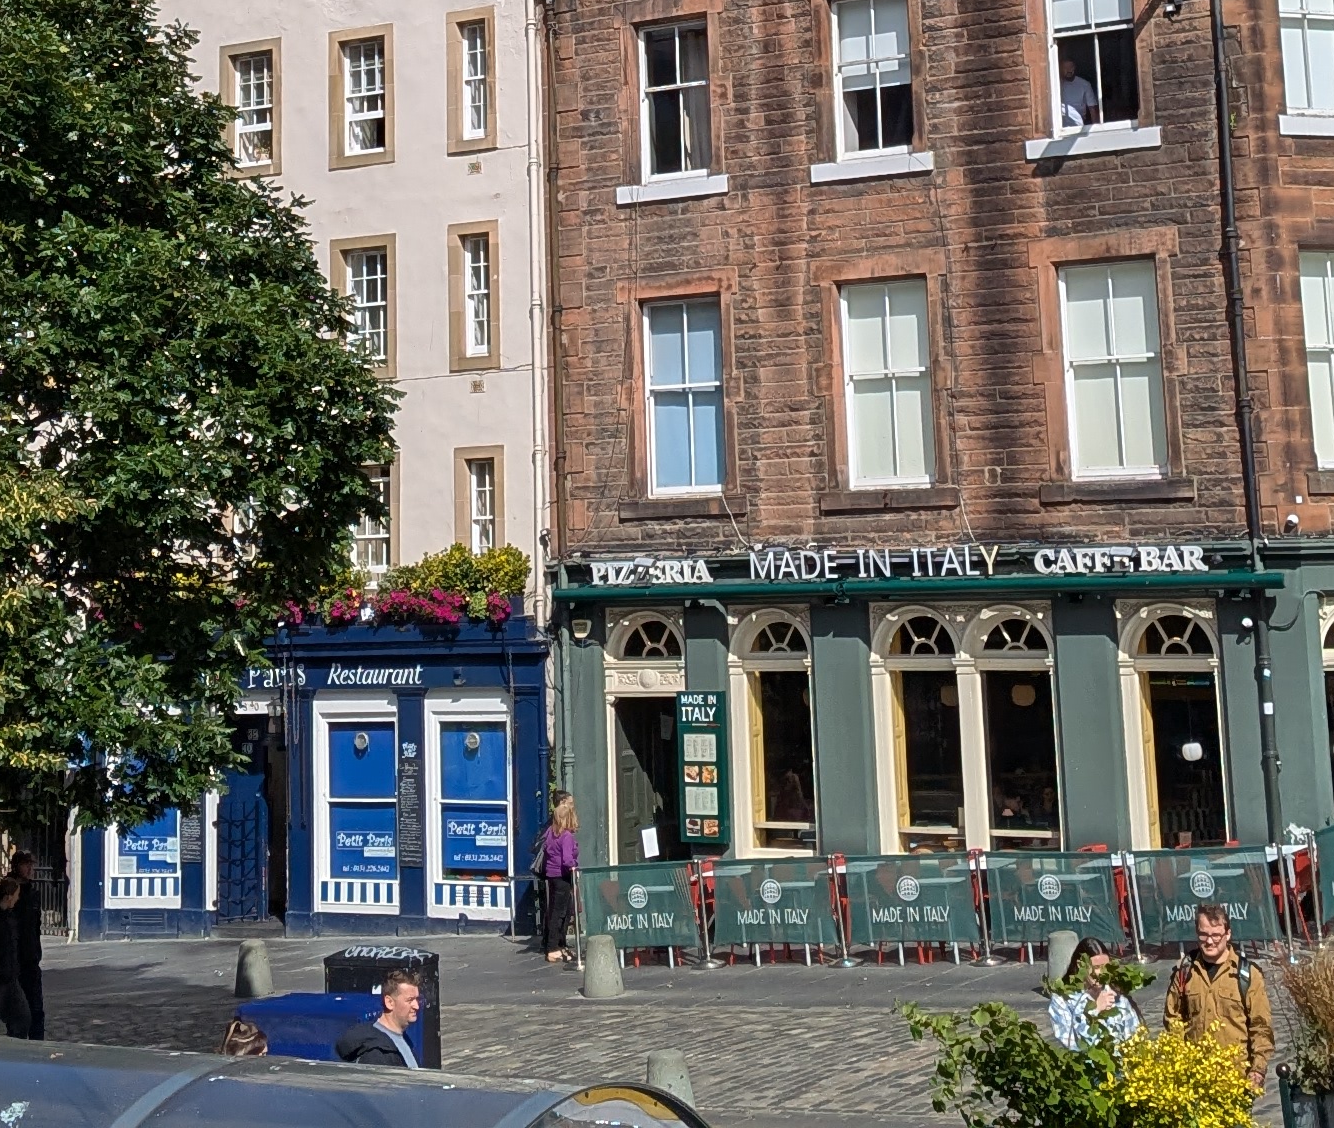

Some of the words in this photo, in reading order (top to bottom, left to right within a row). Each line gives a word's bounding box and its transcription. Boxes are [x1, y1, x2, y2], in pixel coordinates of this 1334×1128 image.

[749, 551, 839, 580] MADE
[856, 549, 892, 578] IN
[910, 545, 999, 577] ITALY
[1137, 545, 1210, 572] BAR
[327, 662, 424, 685] Restaurant
[680, 694, 705, 705] MADE
[707, 694, 717, 705] IN
[680, 706, 717, 722] ITALY
[448, 821, 475, 836] Petit
[479, 821, 507, 836] Paris
[337, 832, 364, 847] Petit
[366, 832, 394, 847] Paris
[737, 909, 764, 925] MADE
[767, 909, 781, 925] IN
[784, 909, 809, 925] ITALY
[872, 906, 903, 923] MADE
[907, 906, 920, 923] IN
[923, 905, 950, 922] ITALY
[1013, 906, 1045, 922] MADE
[1048, 906, 1062, 922] IN
[1065, 906, 1093, 923] ITALY
[1220, 902, 1249, 920] TALY
[607, 914, 634, 931] MADE
[637, 914, 648, 929] IN
[652, 912, 675, 929] ITALY
